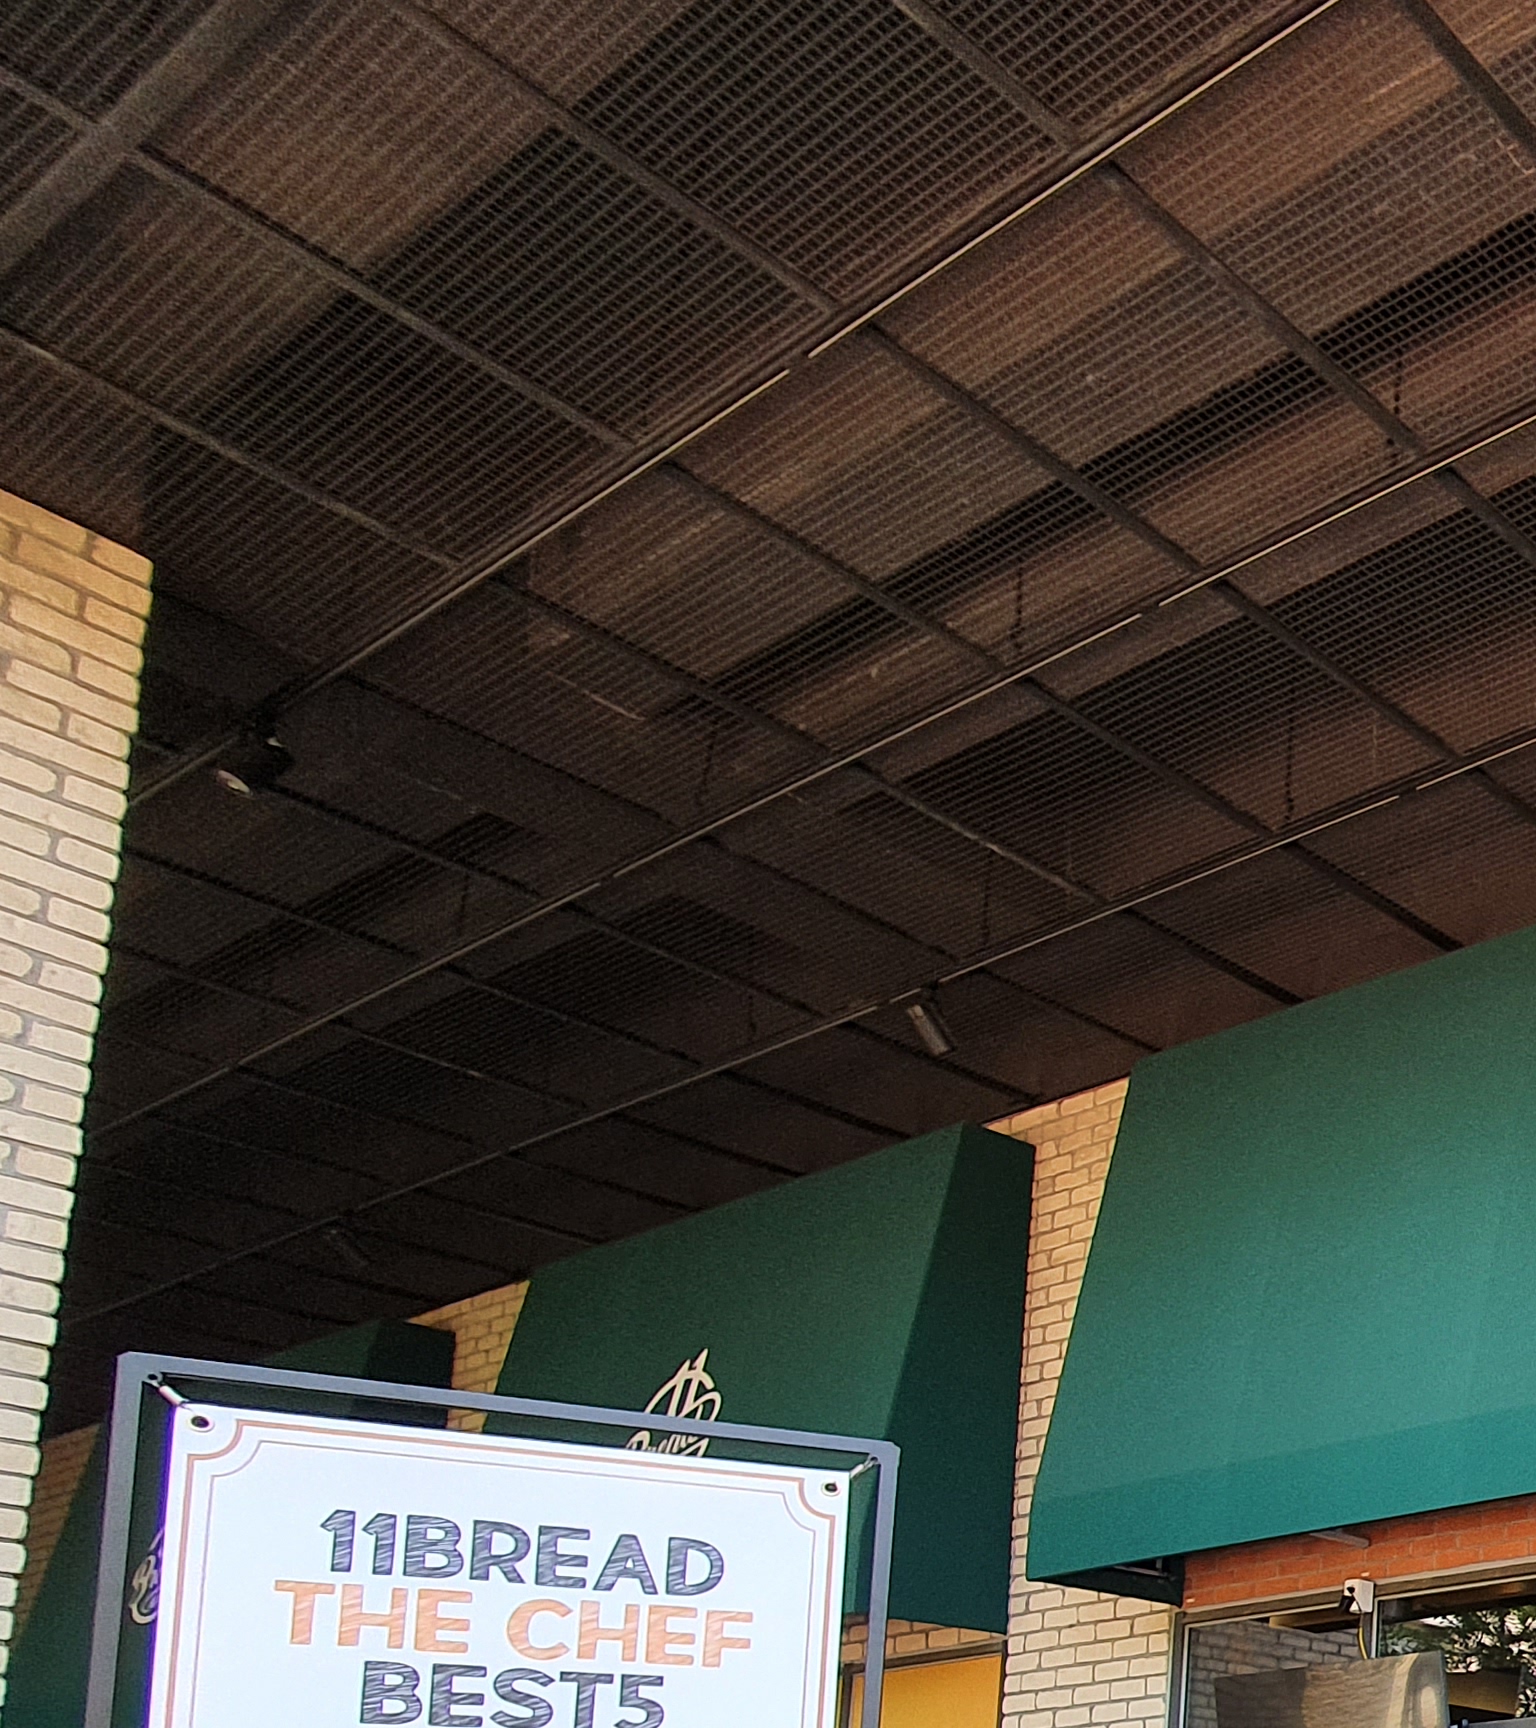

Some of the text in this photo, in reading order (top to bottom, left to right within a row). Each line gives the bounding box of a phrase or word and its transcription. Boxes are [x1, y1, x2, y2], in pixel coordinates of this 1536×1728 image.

[320, 1508, 725, 1597] 11BREAD
[274, 1579, 755, 1668] THE CHEF
